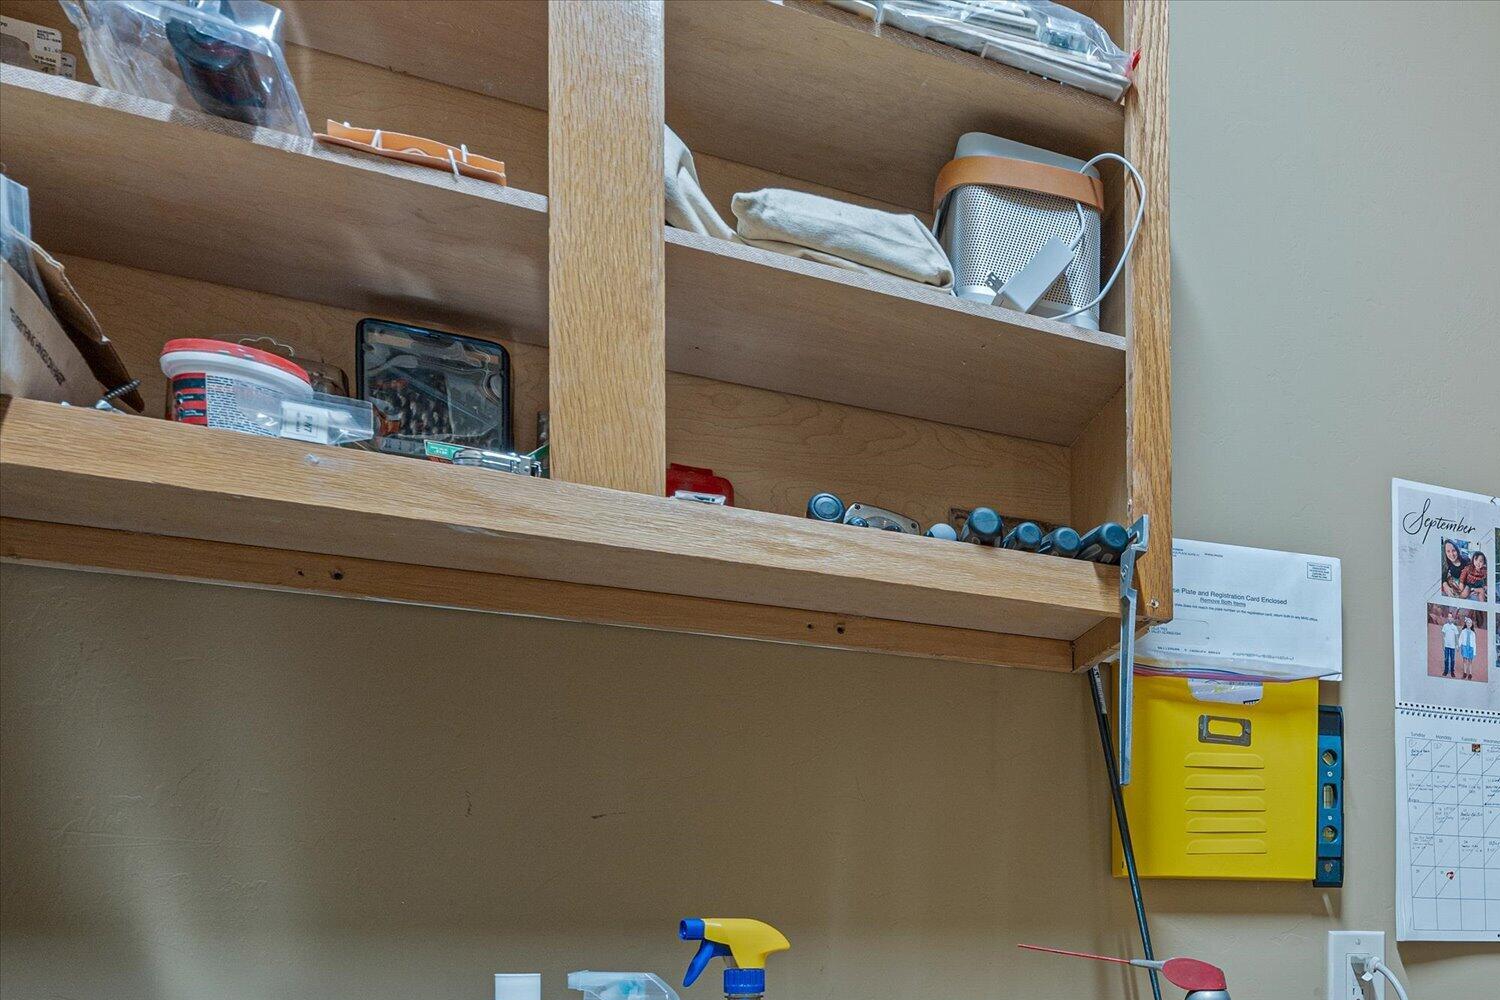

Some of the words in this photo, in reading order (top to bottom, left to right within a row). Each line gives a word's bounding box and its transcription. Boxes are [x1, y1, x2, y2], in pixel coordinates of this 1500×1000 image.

[1403, 498, 1476, 543] September
[1181, 588, 1197, 596] Plate
[1210, 591, 1245, 601] Registration
[1262, 597, 1288, 605] Enclosed
